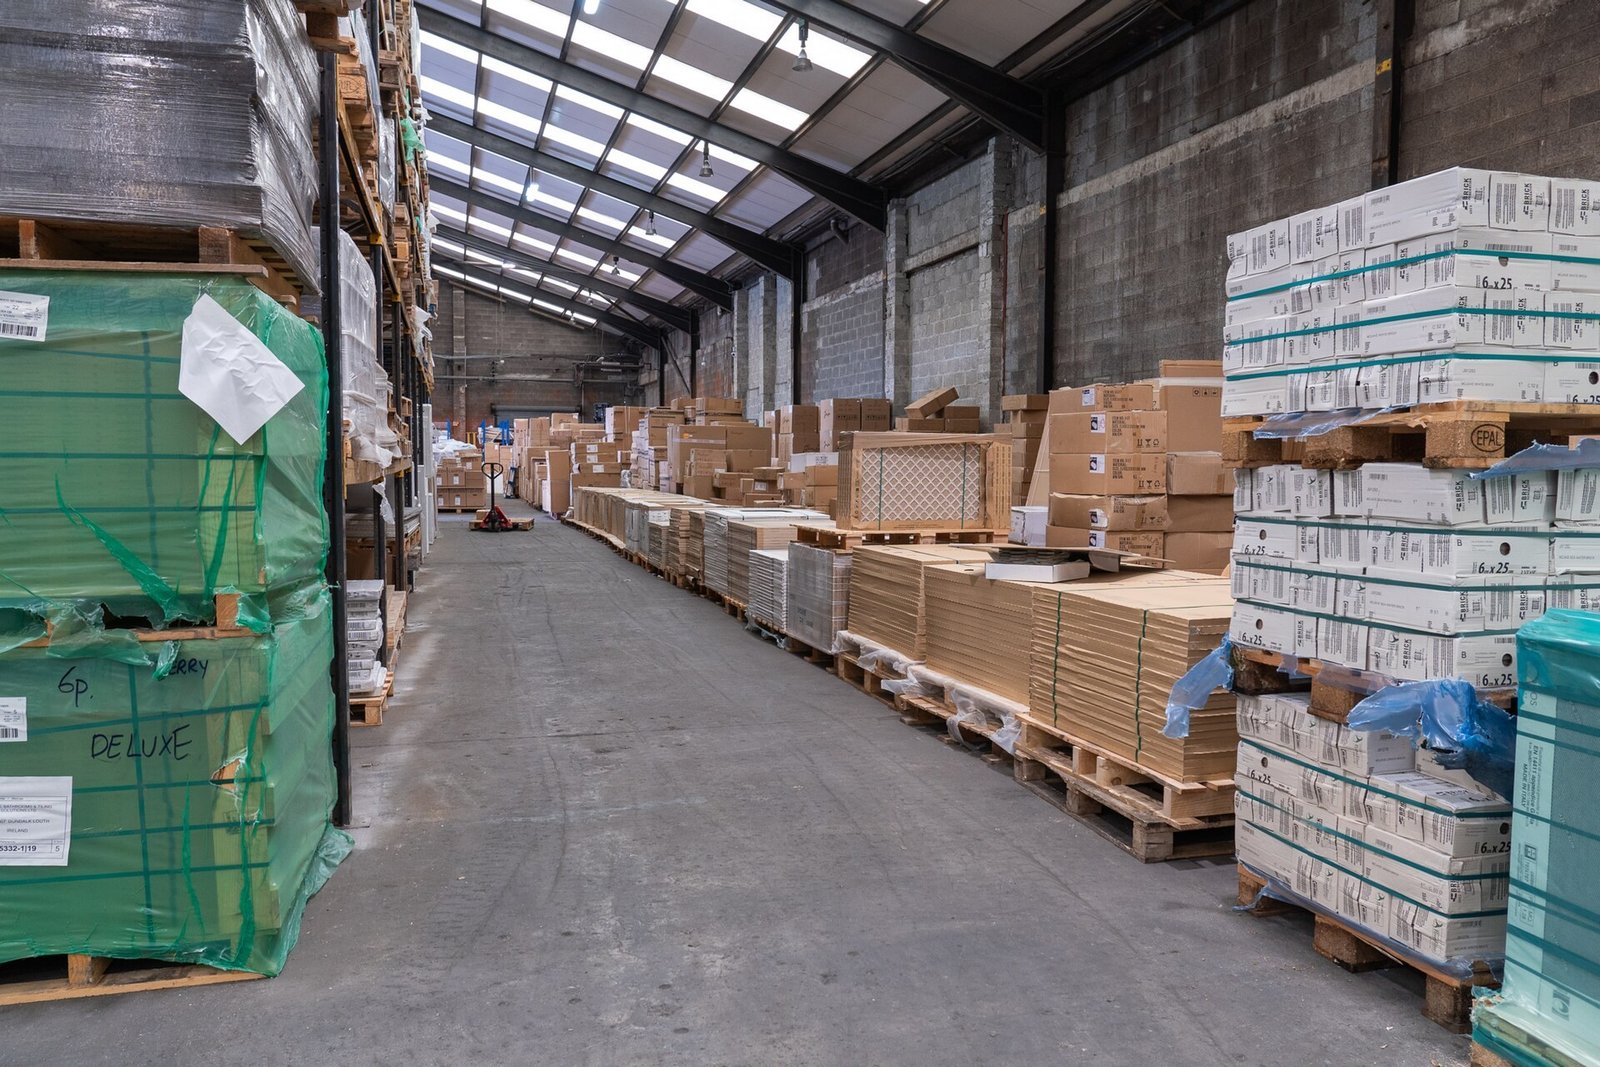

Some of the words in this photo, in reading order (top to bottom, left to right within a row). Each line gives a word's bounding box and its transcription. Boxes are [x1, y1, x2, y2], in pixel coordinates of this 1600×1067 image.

[1476, 430, 1501, 447] EPAL
[1457, 539, 1462, 547] B
[1461, 651, 1467, 659] B
[92, 724, 192, 760] DELUXE
